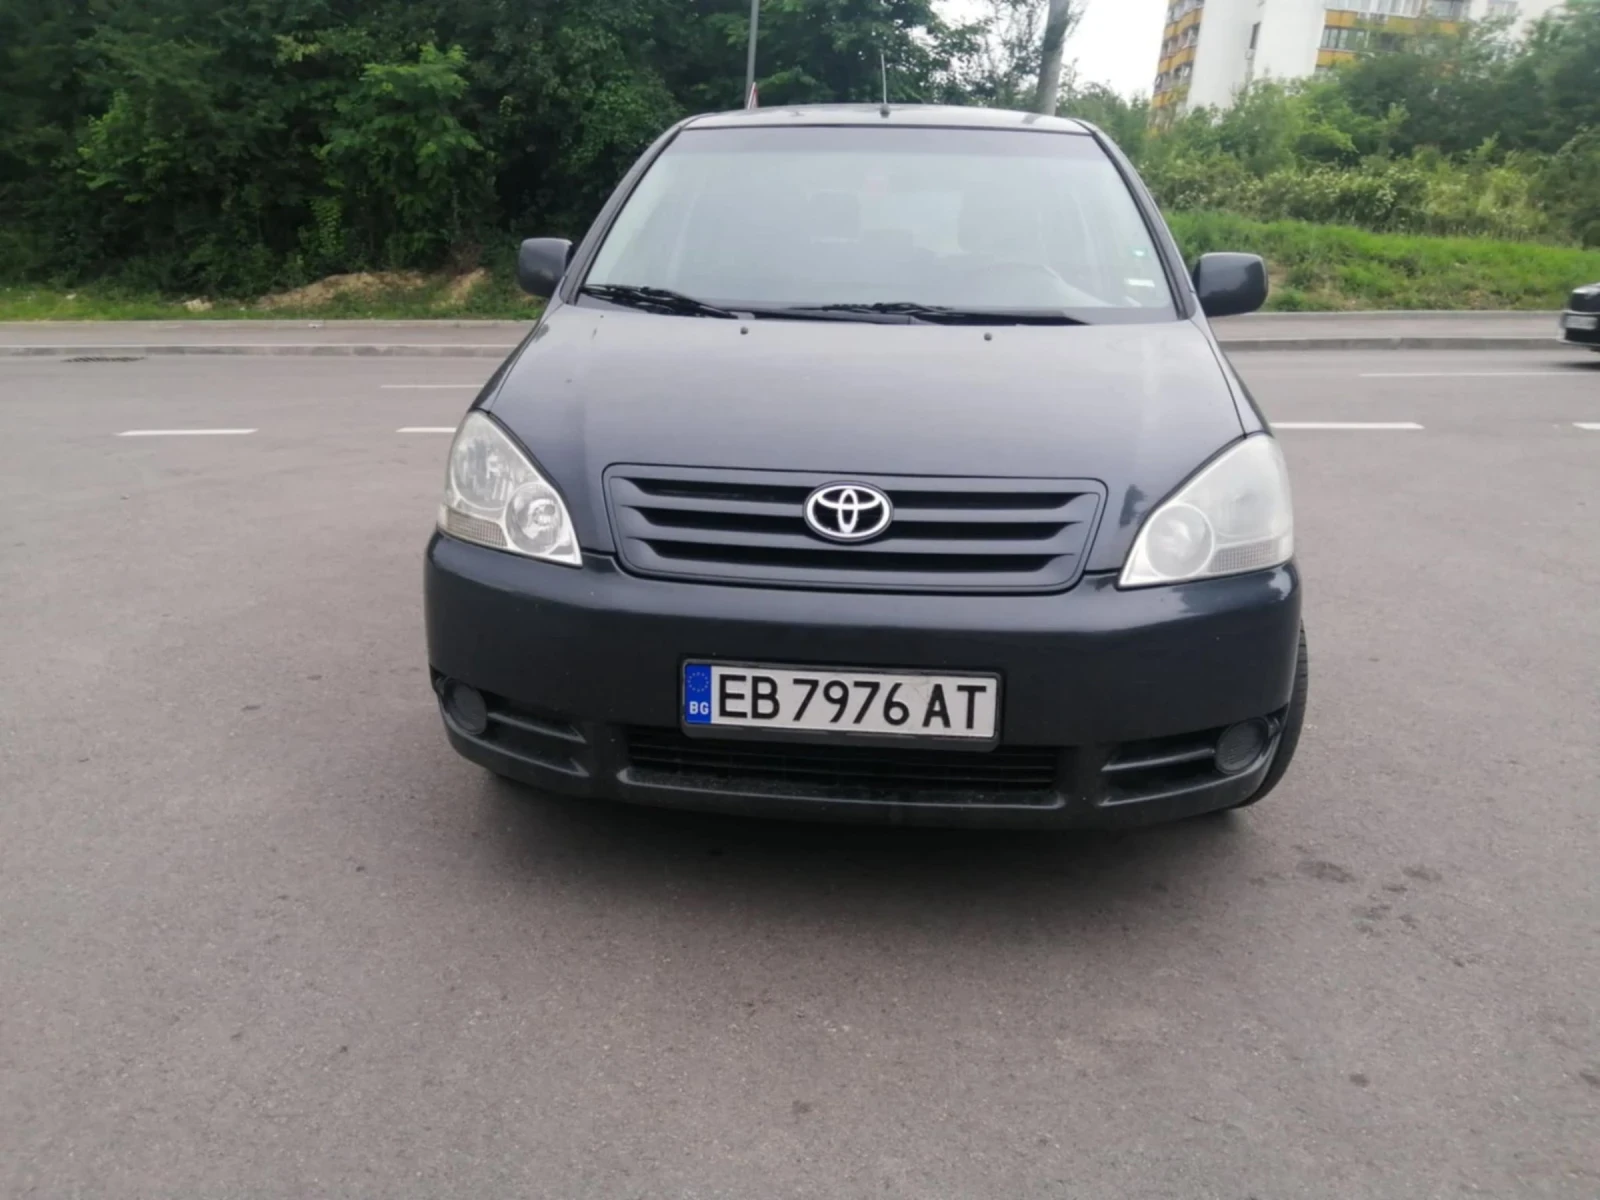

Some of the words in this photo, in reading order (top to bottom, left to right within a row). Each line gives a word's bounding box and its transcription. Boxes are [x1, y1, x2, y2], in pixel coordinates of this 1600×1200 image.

[689, 701, 709, 715] BG
[718, 673, 780, 720] EB
[792, 678, 910, 726] 7976
[922, 683, 987, 730] AT
